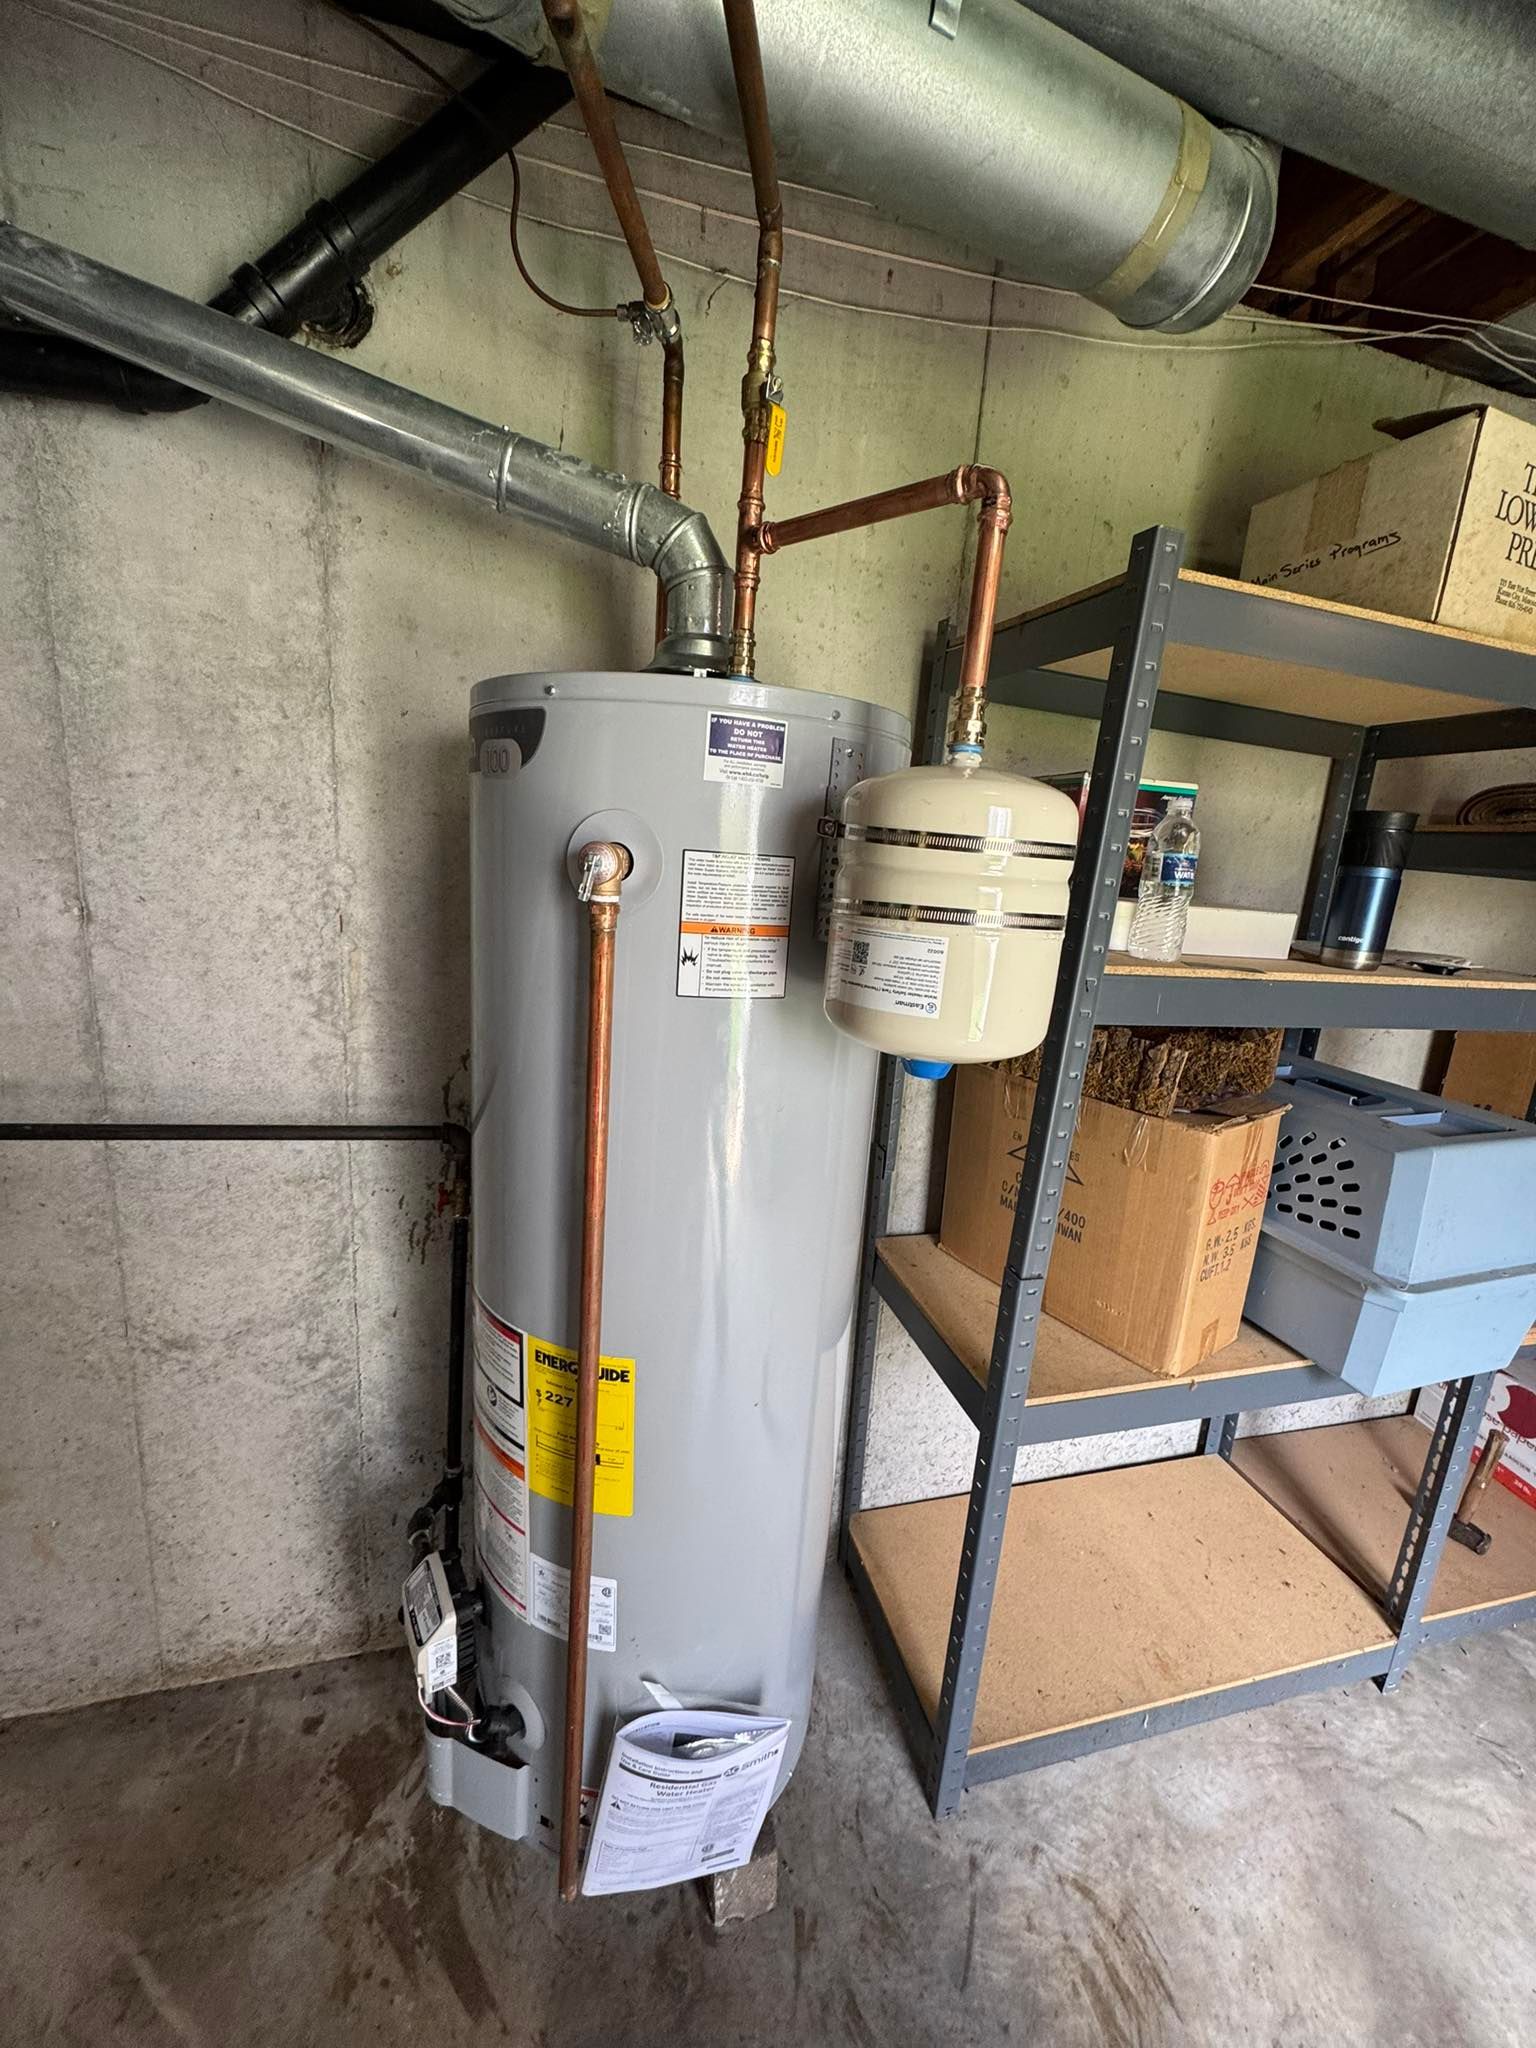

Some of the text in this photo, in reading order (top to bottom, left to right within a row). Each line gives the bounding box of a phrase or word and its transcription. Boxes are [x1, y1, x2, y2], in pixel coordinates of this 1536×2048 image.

[1280, 557, 1321, 578] Series
[1329, 531, 1402, 560] Programs
[734, 719, 750, 727] HAVE
[757, 723, 785, 732] PROBLEM
[747, 730, 764, 738] NOT
[895, 1000, 924, 1009] Eastman
[545, 1390, 574, 1408] 227
[650, 1781, 700, 1791] Residential
[656, 1790, 683, 1798] Water
[685, 1786, 715, 1797] Heater
